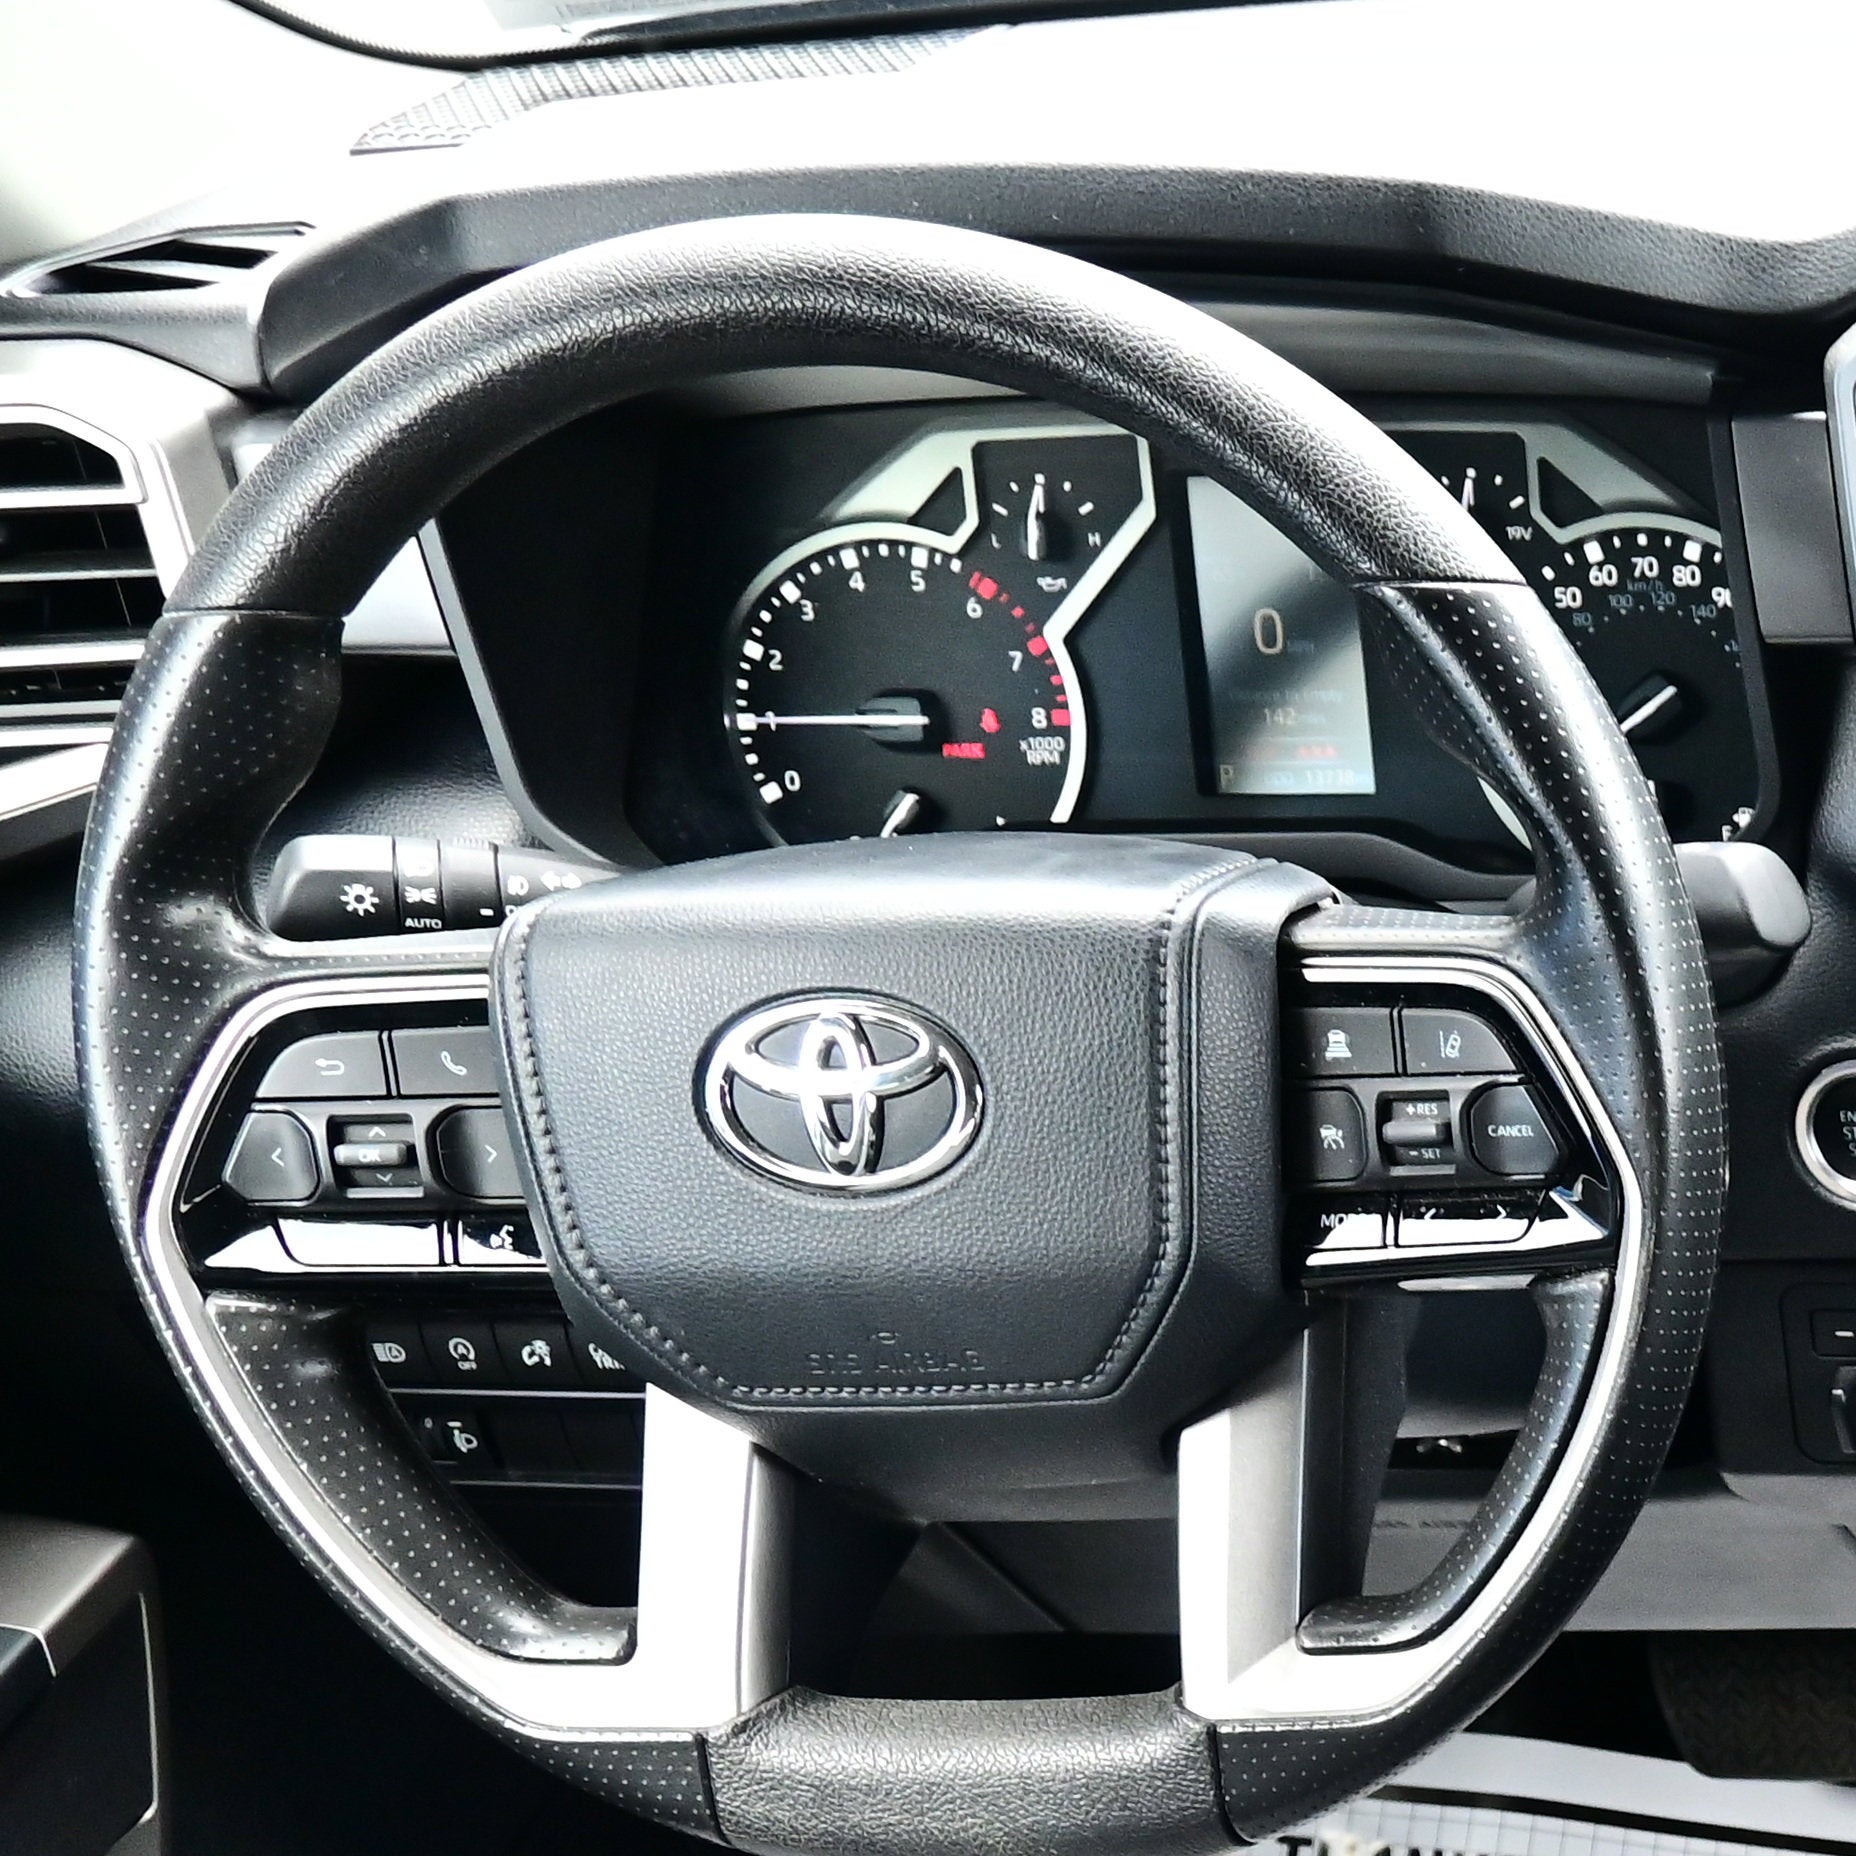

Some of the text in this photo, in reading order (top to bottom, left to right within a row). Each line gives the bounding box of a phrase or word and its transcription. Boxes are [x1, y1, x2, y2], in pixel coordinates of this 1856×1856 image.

[1588, 563, 1619, 587] 60
[1630, 555, 1660, 579] 70
[1671, 564, 1702, 588] 80
[848, 571, 866, 593] 4
[910, 571, 928, 592] 5
[1626, 579, 1664, 592] km/h
[1553, 585, 1583, 609] 50
[1608, 594, 1634, 607] 100
[1650, 592, 1676, 606] 120
[799, 600, 817, 622] 3
[966, 599, 984, 619] 6
[1572, 612, 1593, 627] 80
[1690, 604, 1717, 618] 140
[1253, 607, 1284, 655] 0
[767, 649, 784, 671] 2
[1007, 652, 1024, 672] 7
[1030, 707, 1048, 730] 8
[1026, 750, 1061, 766] RPM
[783, 769, 801, 791] 0
[403, 916, 443, 930] AUTO
[1487, 1124, 1535, 1138] CANCEL
